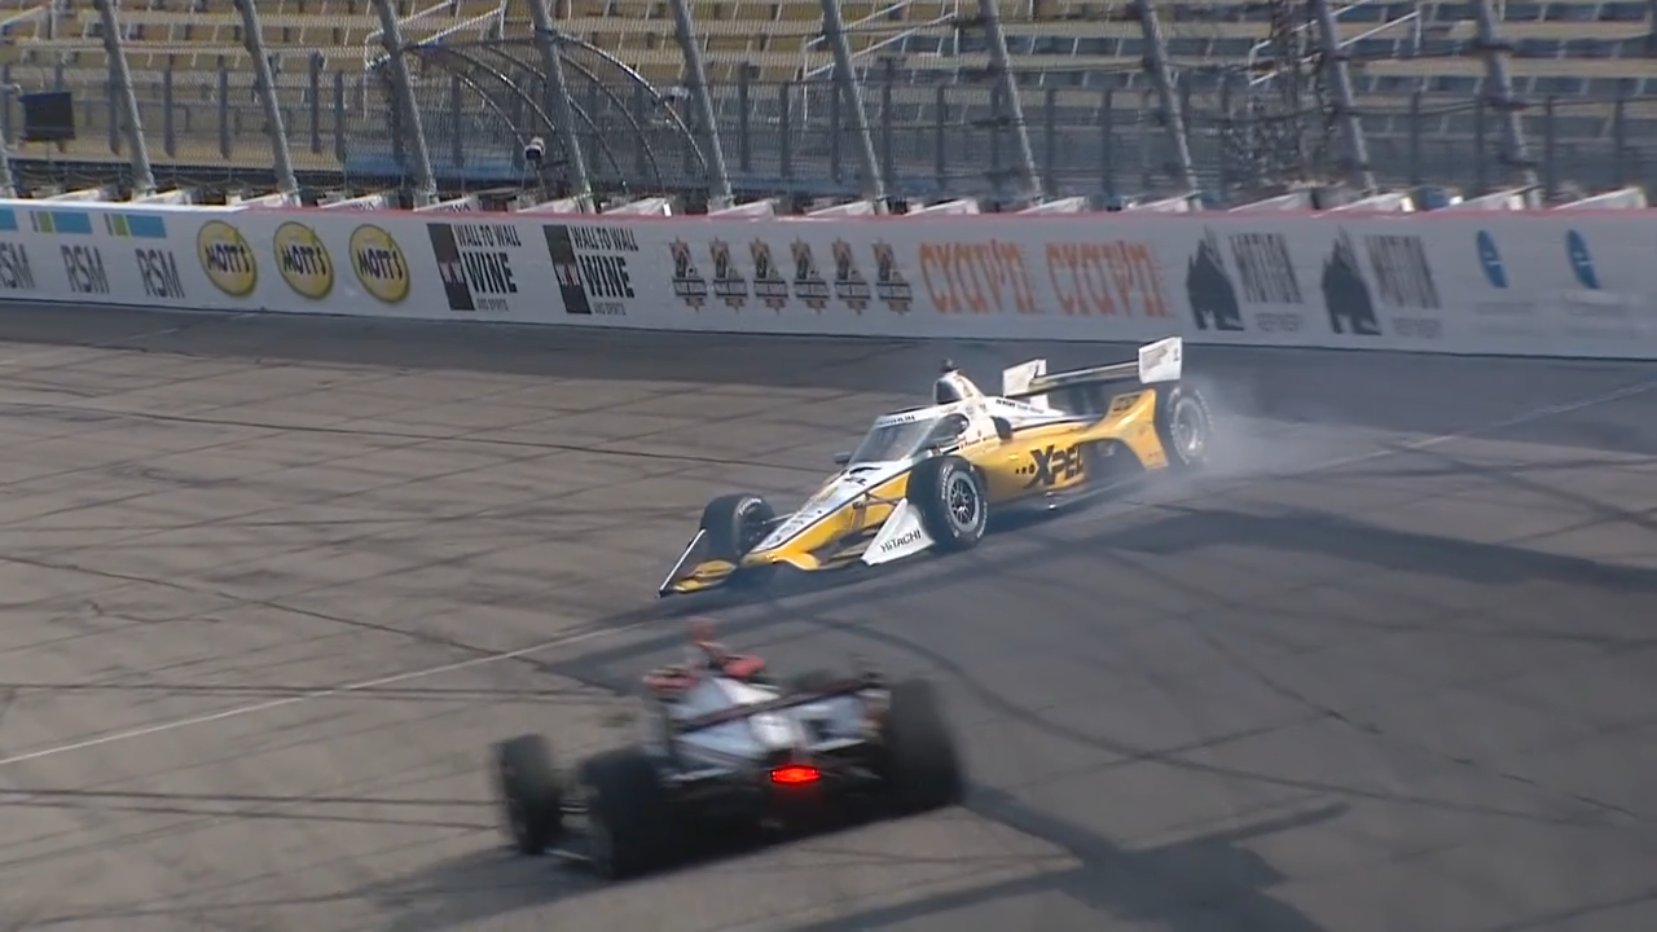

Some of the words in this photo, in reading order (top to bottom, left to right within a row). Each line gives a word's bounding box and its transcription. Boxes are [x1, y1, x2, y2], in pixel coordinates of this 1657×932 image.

[454, 224, 482, 246] WALL
[479, 224, 494, 247] TO
[492, 224, 521, 247] WALL
[570, 226, 600, 250] WALL
[596, 227, 612, 250] TO
[609, 227, 639, 251] WALL
[61, 244, 110, 294] RSM
[134, 248, 186, 298] RSM
[462, 252, 518, 294] WINE
[578, 255, 635, 298] WINE
[880, 528, 921, 552] HITACHI
